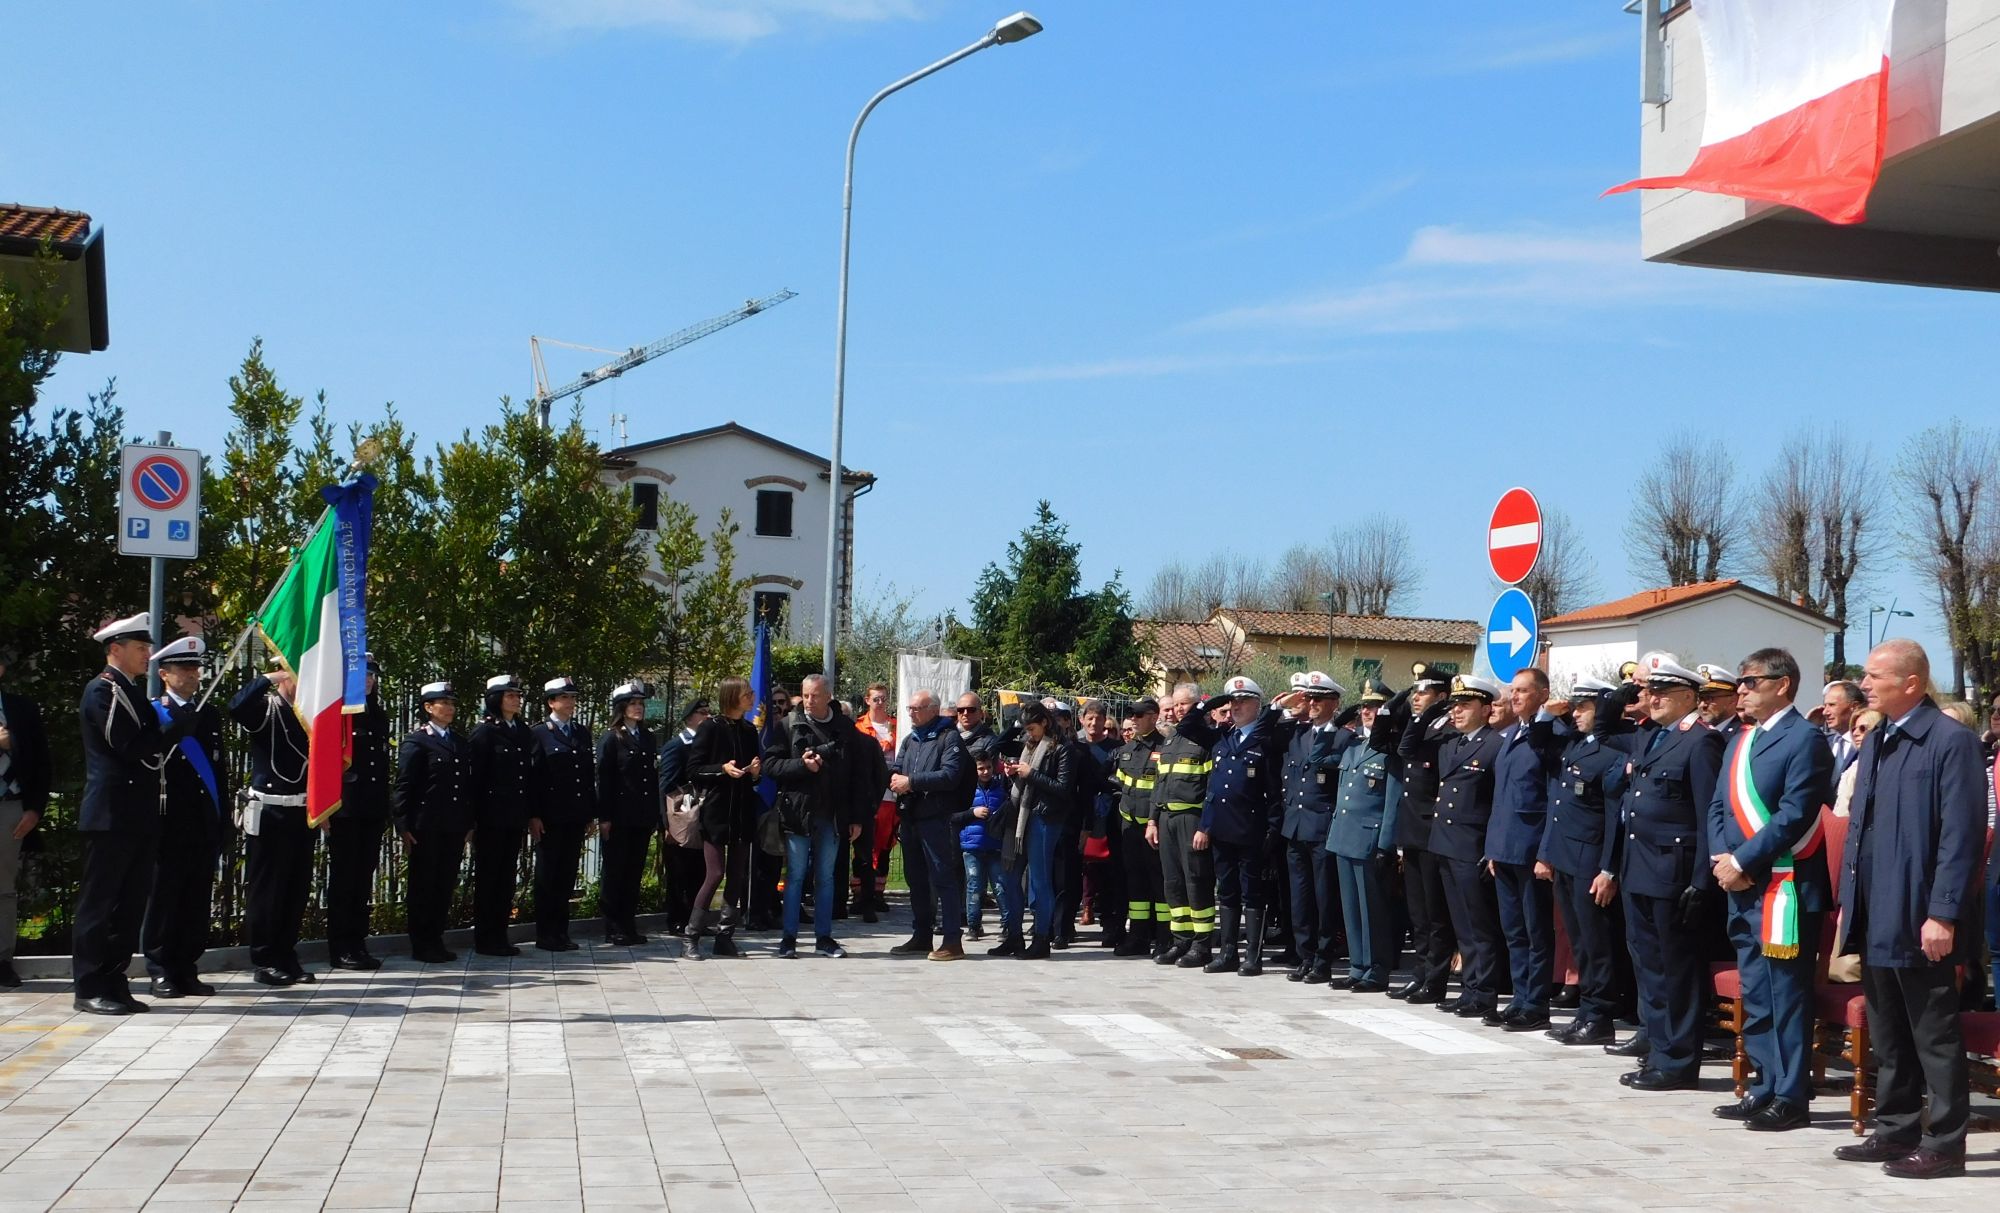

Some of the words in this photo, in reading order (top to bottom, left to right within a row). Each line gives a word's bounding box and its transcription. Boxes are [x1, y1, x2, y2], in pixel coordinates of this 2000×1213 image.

[132, 519, 146, 537] P
[341, 520, 356, 608] MUNICIPALE
[344, 615, 358, 671] POLIZIA
